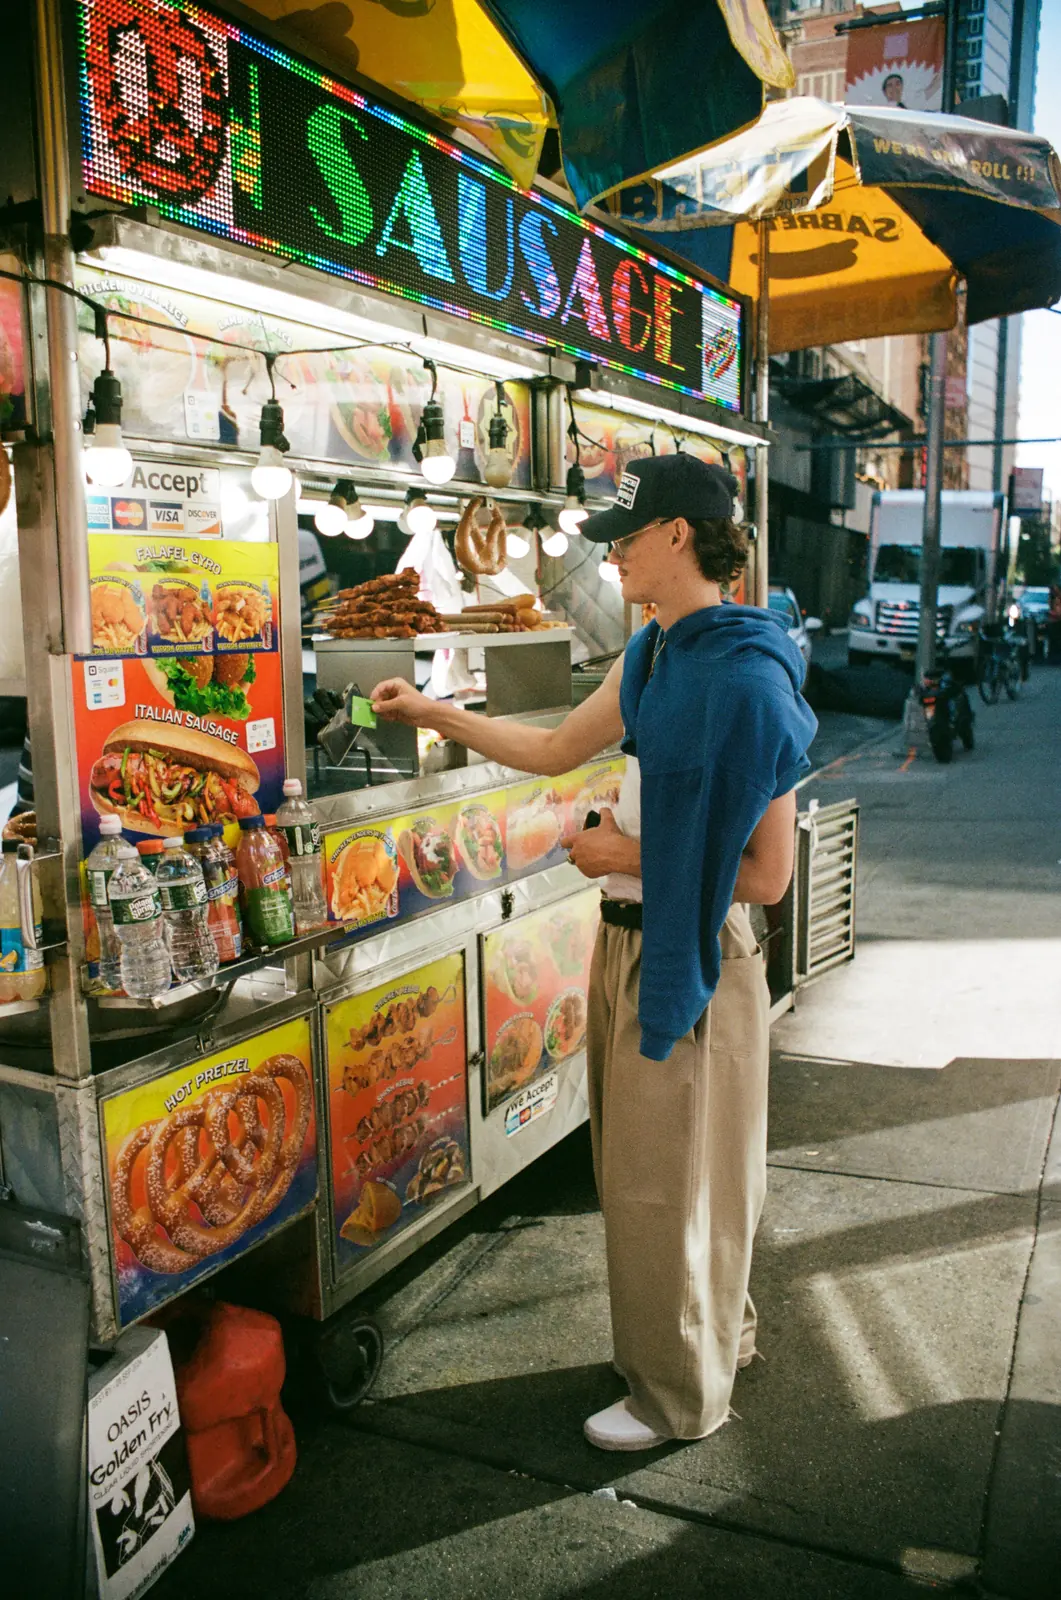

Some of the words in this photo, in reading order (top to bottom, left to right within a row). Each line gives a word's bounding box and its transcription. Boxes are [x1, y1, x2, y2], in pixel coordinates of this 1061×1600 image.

[971, 160, 1011, 180] ROLL
[306, 102, 686, 372] SAUSAGE
[78, 279, 126, 297] HICKEN
[131, 466, 209, 498] Accept
[155, 510, 179, 523] VISA
[187, 509, 217, 519] DISCOVER
[135, 545, 189, 562] FALAFEL
[190, 551, 222, 576] GYRO
[98, 664, 120, 674] Square
[134, 703, 184, 726] ITALIAN
[184, 713, 240, 747] SAUSAGE
[164, 1079, 195, 1112] HOT
[195, 1058, 251, 1089] PRETZEL
[526, 1077, 554, 1104] Accept
[108, 1391, 151, 1443] OASIS
[90, 1429, 147, 1486] Golden
[147, 1401, 171, 1434] Fry
[93, 1478, 119, 1501] CLEAR
